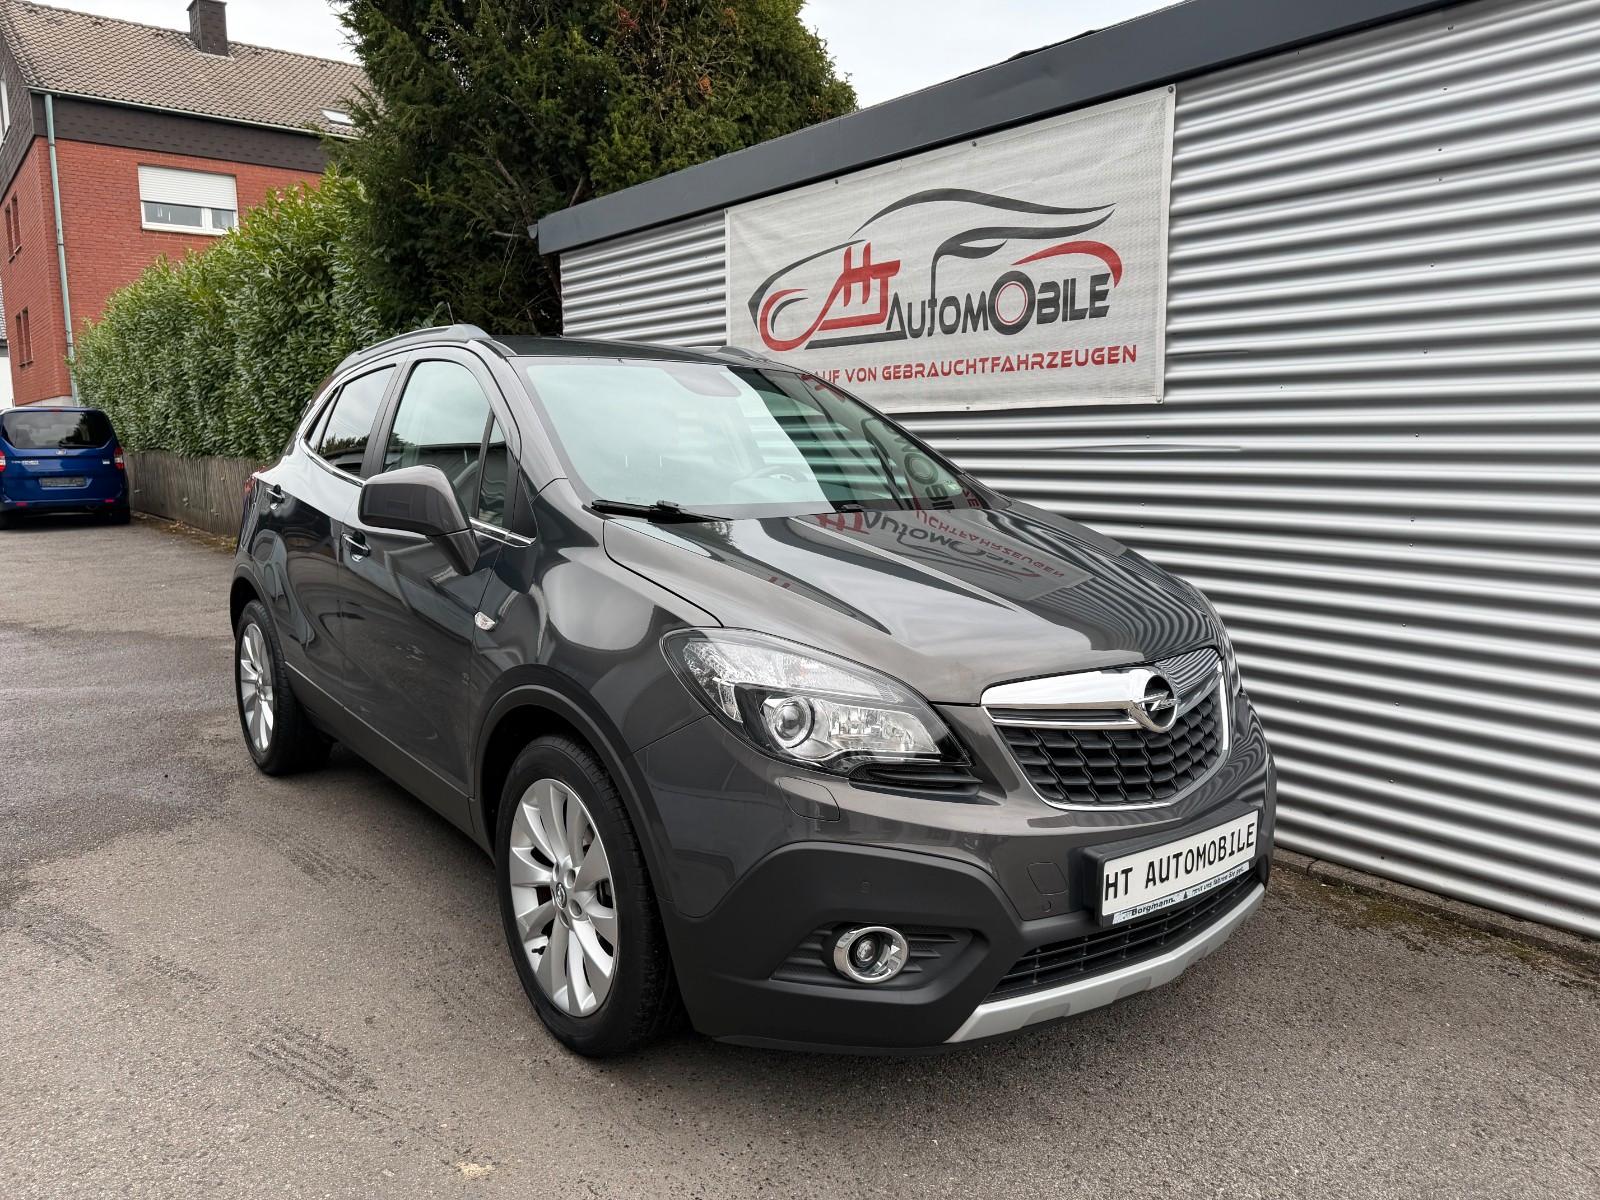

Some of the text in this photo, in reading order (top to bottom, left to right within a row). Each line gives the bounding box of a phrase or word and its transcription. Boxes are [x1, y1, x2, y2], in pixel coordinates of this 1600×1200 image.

[886, 269, 1111, 339] AUTOMOBILE
[845, 367, 877, 383] VON
[882, 345, 1137, 381] GEBRAUCHTFAHRZEUGEN
[1104, 823, 1255, 901] HT AUTOMOBILE
